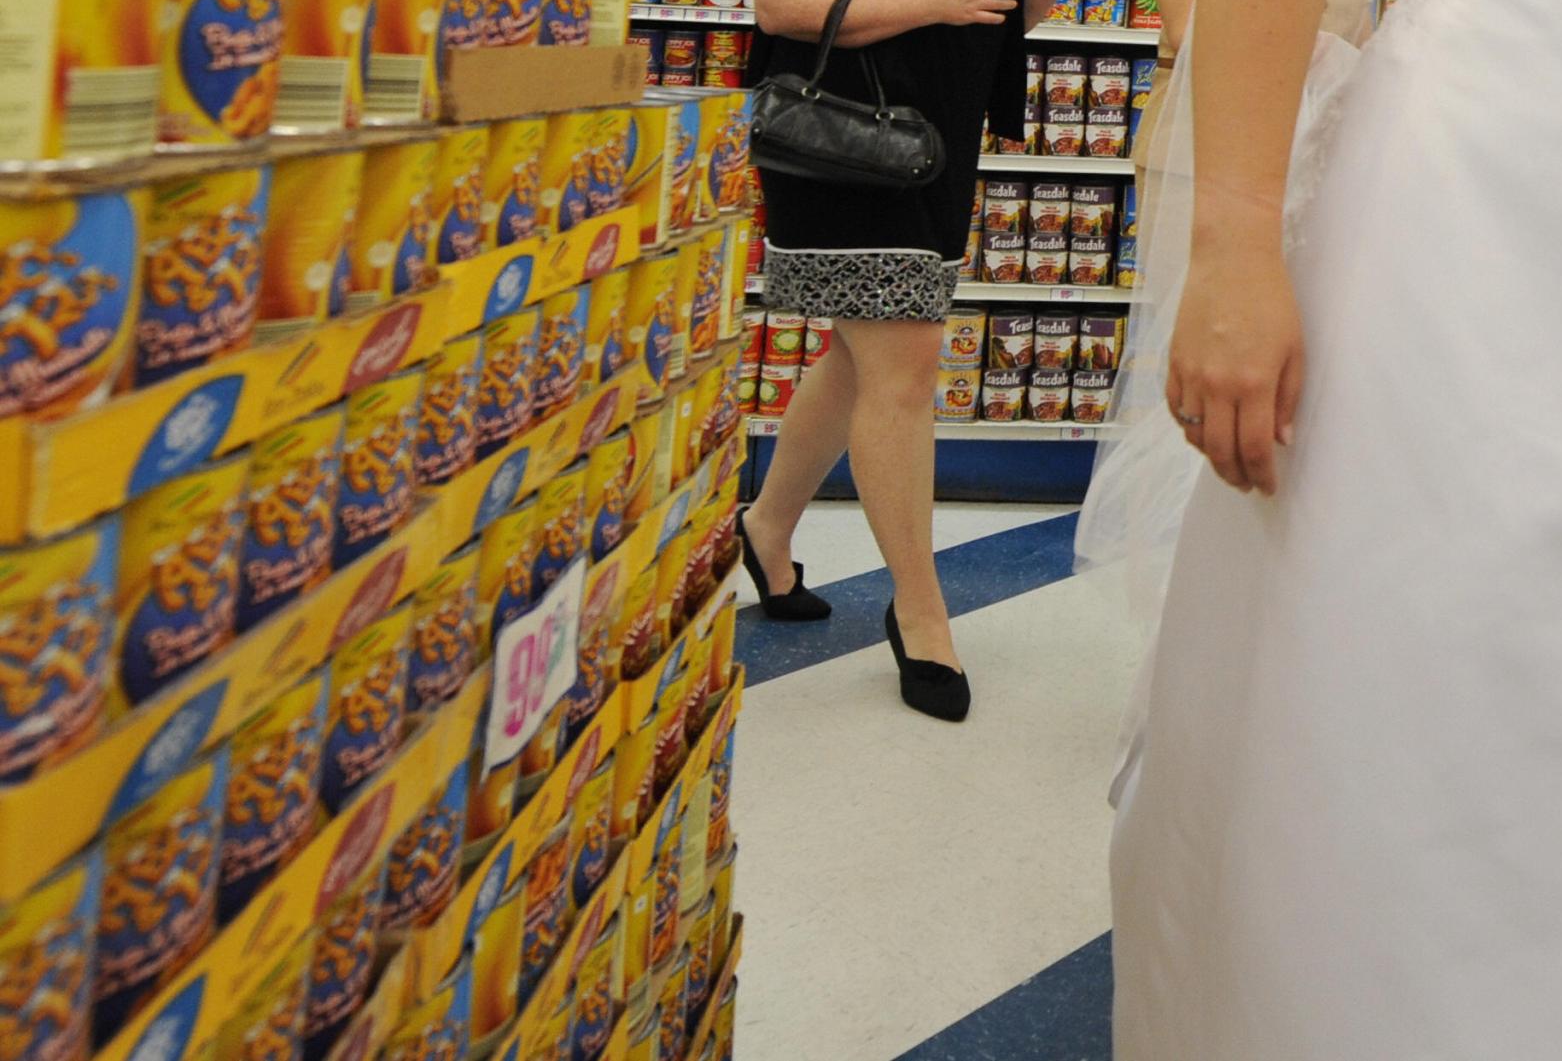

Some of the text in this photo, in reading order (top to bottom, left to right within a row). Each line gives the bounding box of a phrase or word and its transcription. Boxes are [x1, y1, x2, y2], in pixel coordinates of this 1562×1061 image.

[1096, 60, 1130, 74] Teasdal
[1088, 110, 1124, 123] Teasdale
[987, 185, 1017, 198] asdale
[1073, 187, 1099, 202] sdale
[990, 235, 1025, 250] Teasdal
[1030, 236, 1066, 250] Teasdale
